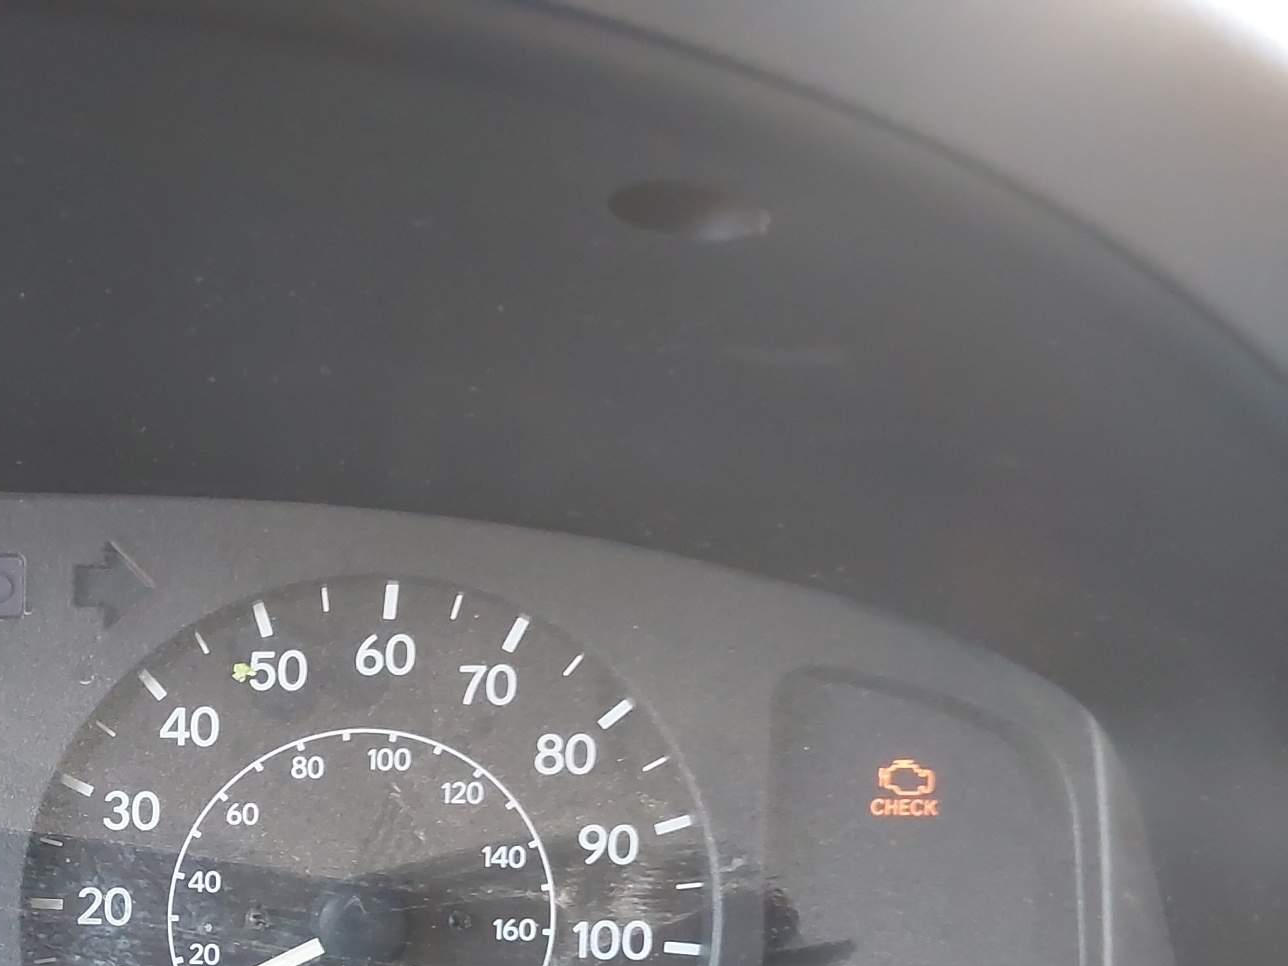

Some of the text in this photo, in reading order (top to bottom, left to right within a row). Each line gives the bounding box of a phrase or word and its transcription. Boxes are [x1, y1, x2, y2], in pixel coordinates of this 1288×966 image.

[246, 649, 308, 692] 50
[355, 633, 416, 676] 60
[459, 663, 517, 706] 70
[159, 706, 220, 747] 40
[290, 755, 325, 779] 80
[367, 747, 412, 771] 100
[534, 733, 596, 776] 80
[441, 781, 484, 805] 120
[870, 798, 938, 817] CHECK
[103, 790, 161, 831] 30
[226, 802, 259, 826] 60
[481, 845, 527, 869] 140
[578, 824, 639, 866] 90
[187, 870, 222, 893] 40
[77, 886, 132, 927] 20
[492, 918, 538, 942] 160
[573, 919, 654, 962] 100
[188, 943, 220, 966] 20
